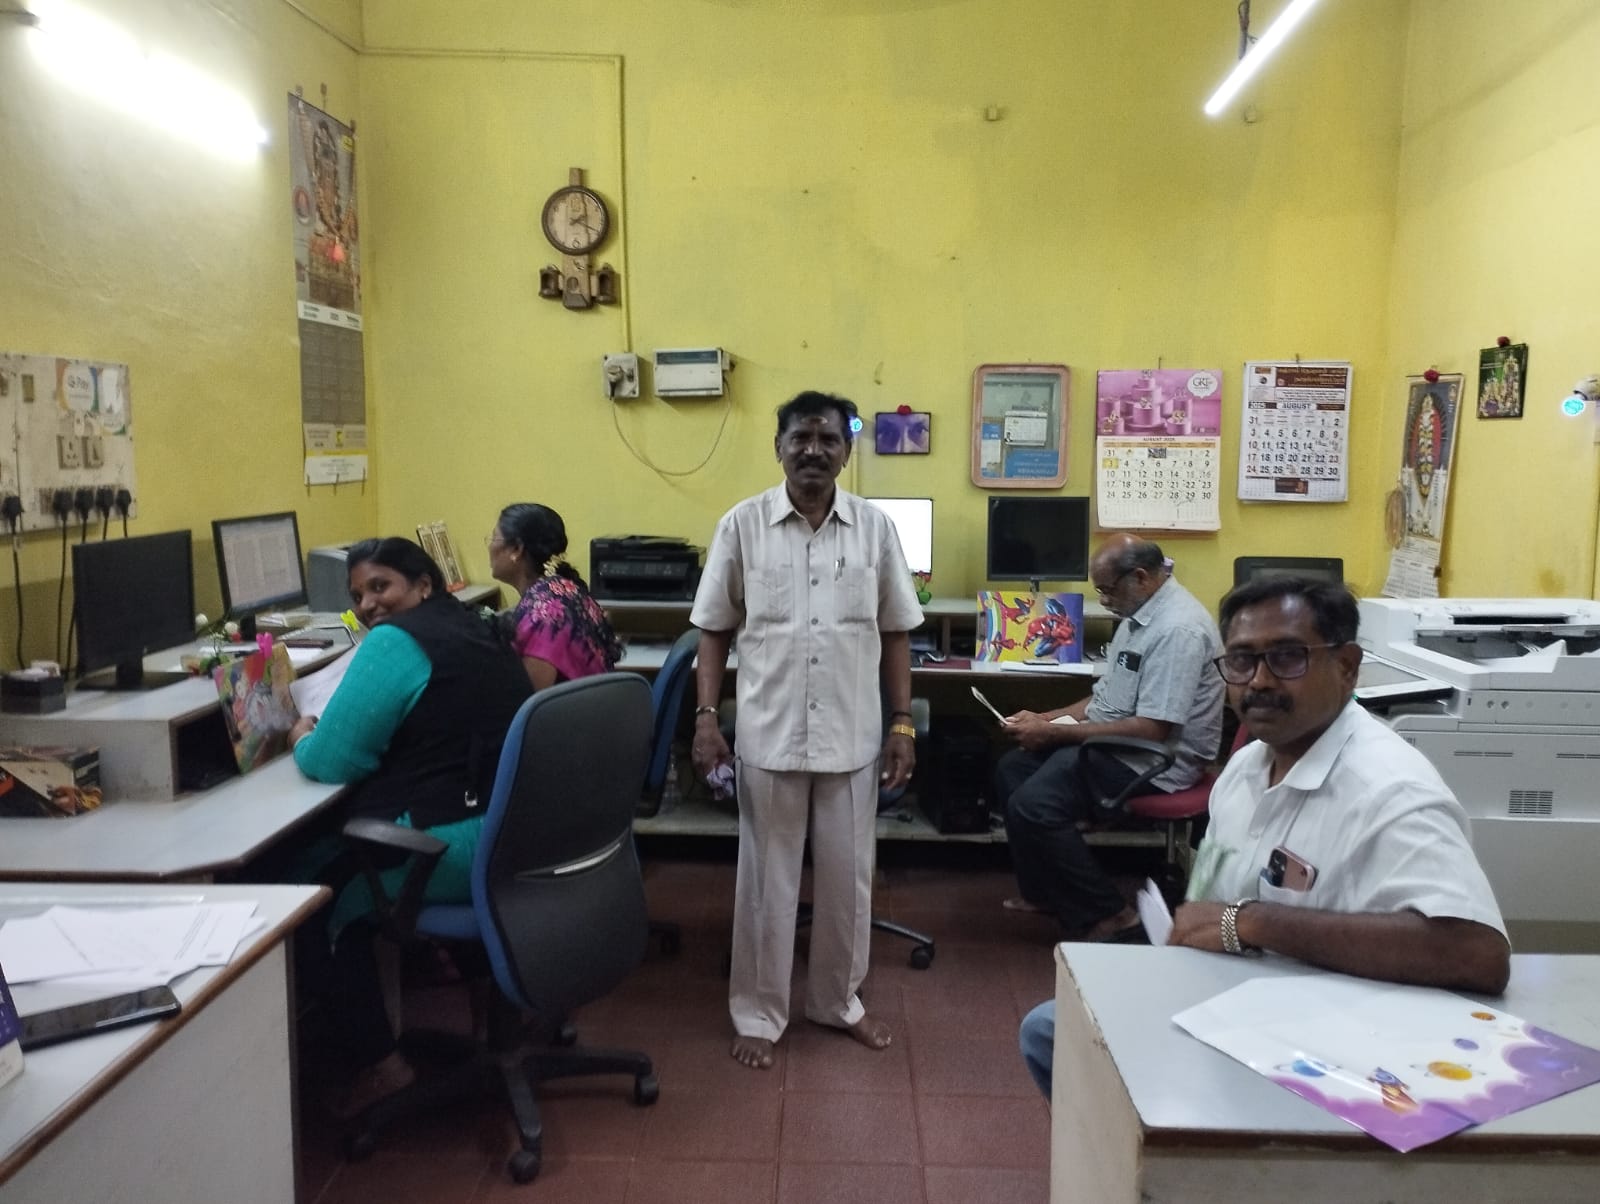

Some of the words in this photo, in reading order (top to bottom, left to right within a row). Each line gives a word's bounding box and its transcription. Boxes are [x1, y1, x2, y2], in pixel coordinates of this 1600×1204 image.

[1249, 416, 1258, 424] 31
[1334, 418, 1339, 426] 2
[1251, 429, 1256, 437] 3
[1278, 429, 1283, 437] 5
[1292, 429, 1297, 437] 6
[1320, 430, 1325, 438] 8
[1276, 441, 1285, 449] 12
[1329, 455, 1339, 463] 23
[1247, 465, 1256, 473] 24
[1301, 466, 1310, 474] 28
[1314, 467, 1323, 475] 29
[1185, 481, 1195, 489] 22
[1202, 481, 1211, 489] 23
